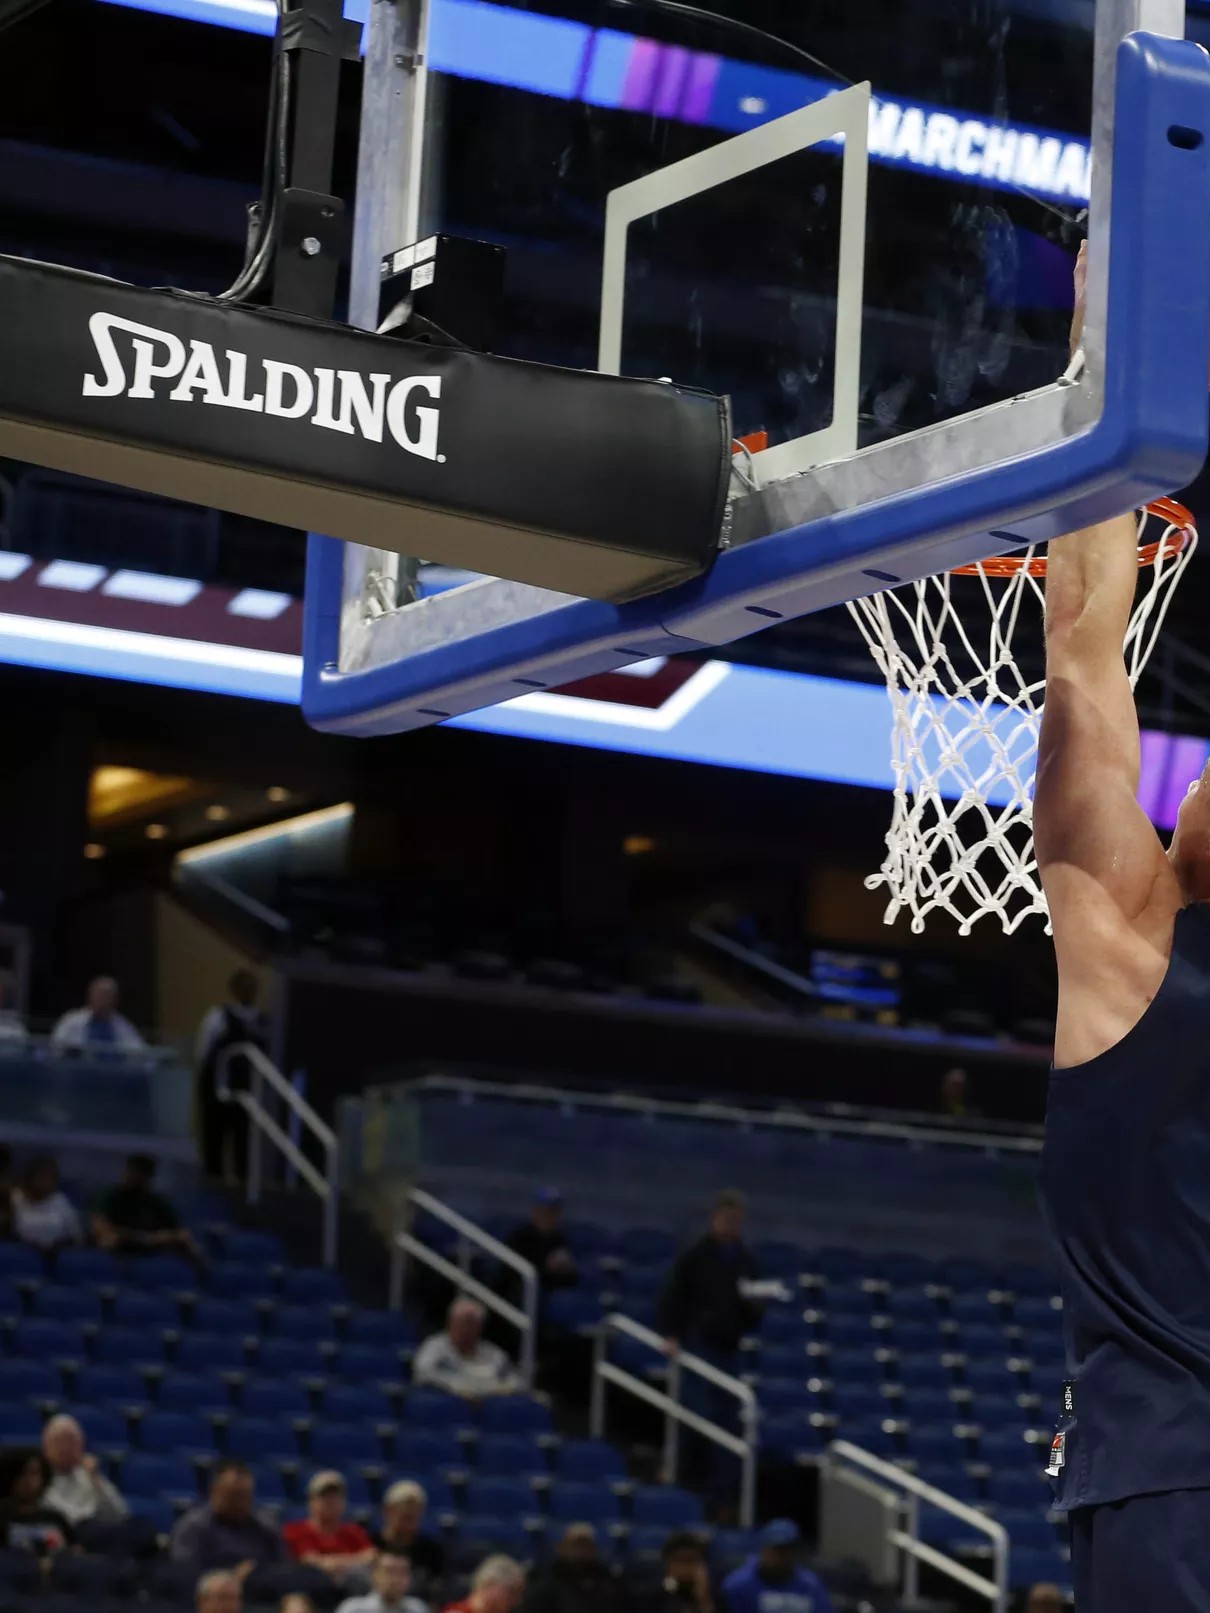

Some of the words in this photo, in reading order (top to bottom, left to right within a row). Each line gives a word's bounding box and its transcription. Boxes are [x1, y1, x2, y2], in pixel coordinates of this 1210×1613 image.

[866, 97, 1093, 200] MARCHMA
[82, 311, 443, 462] SPALDING
[1064, 1386, 1073, 1411] MENS
